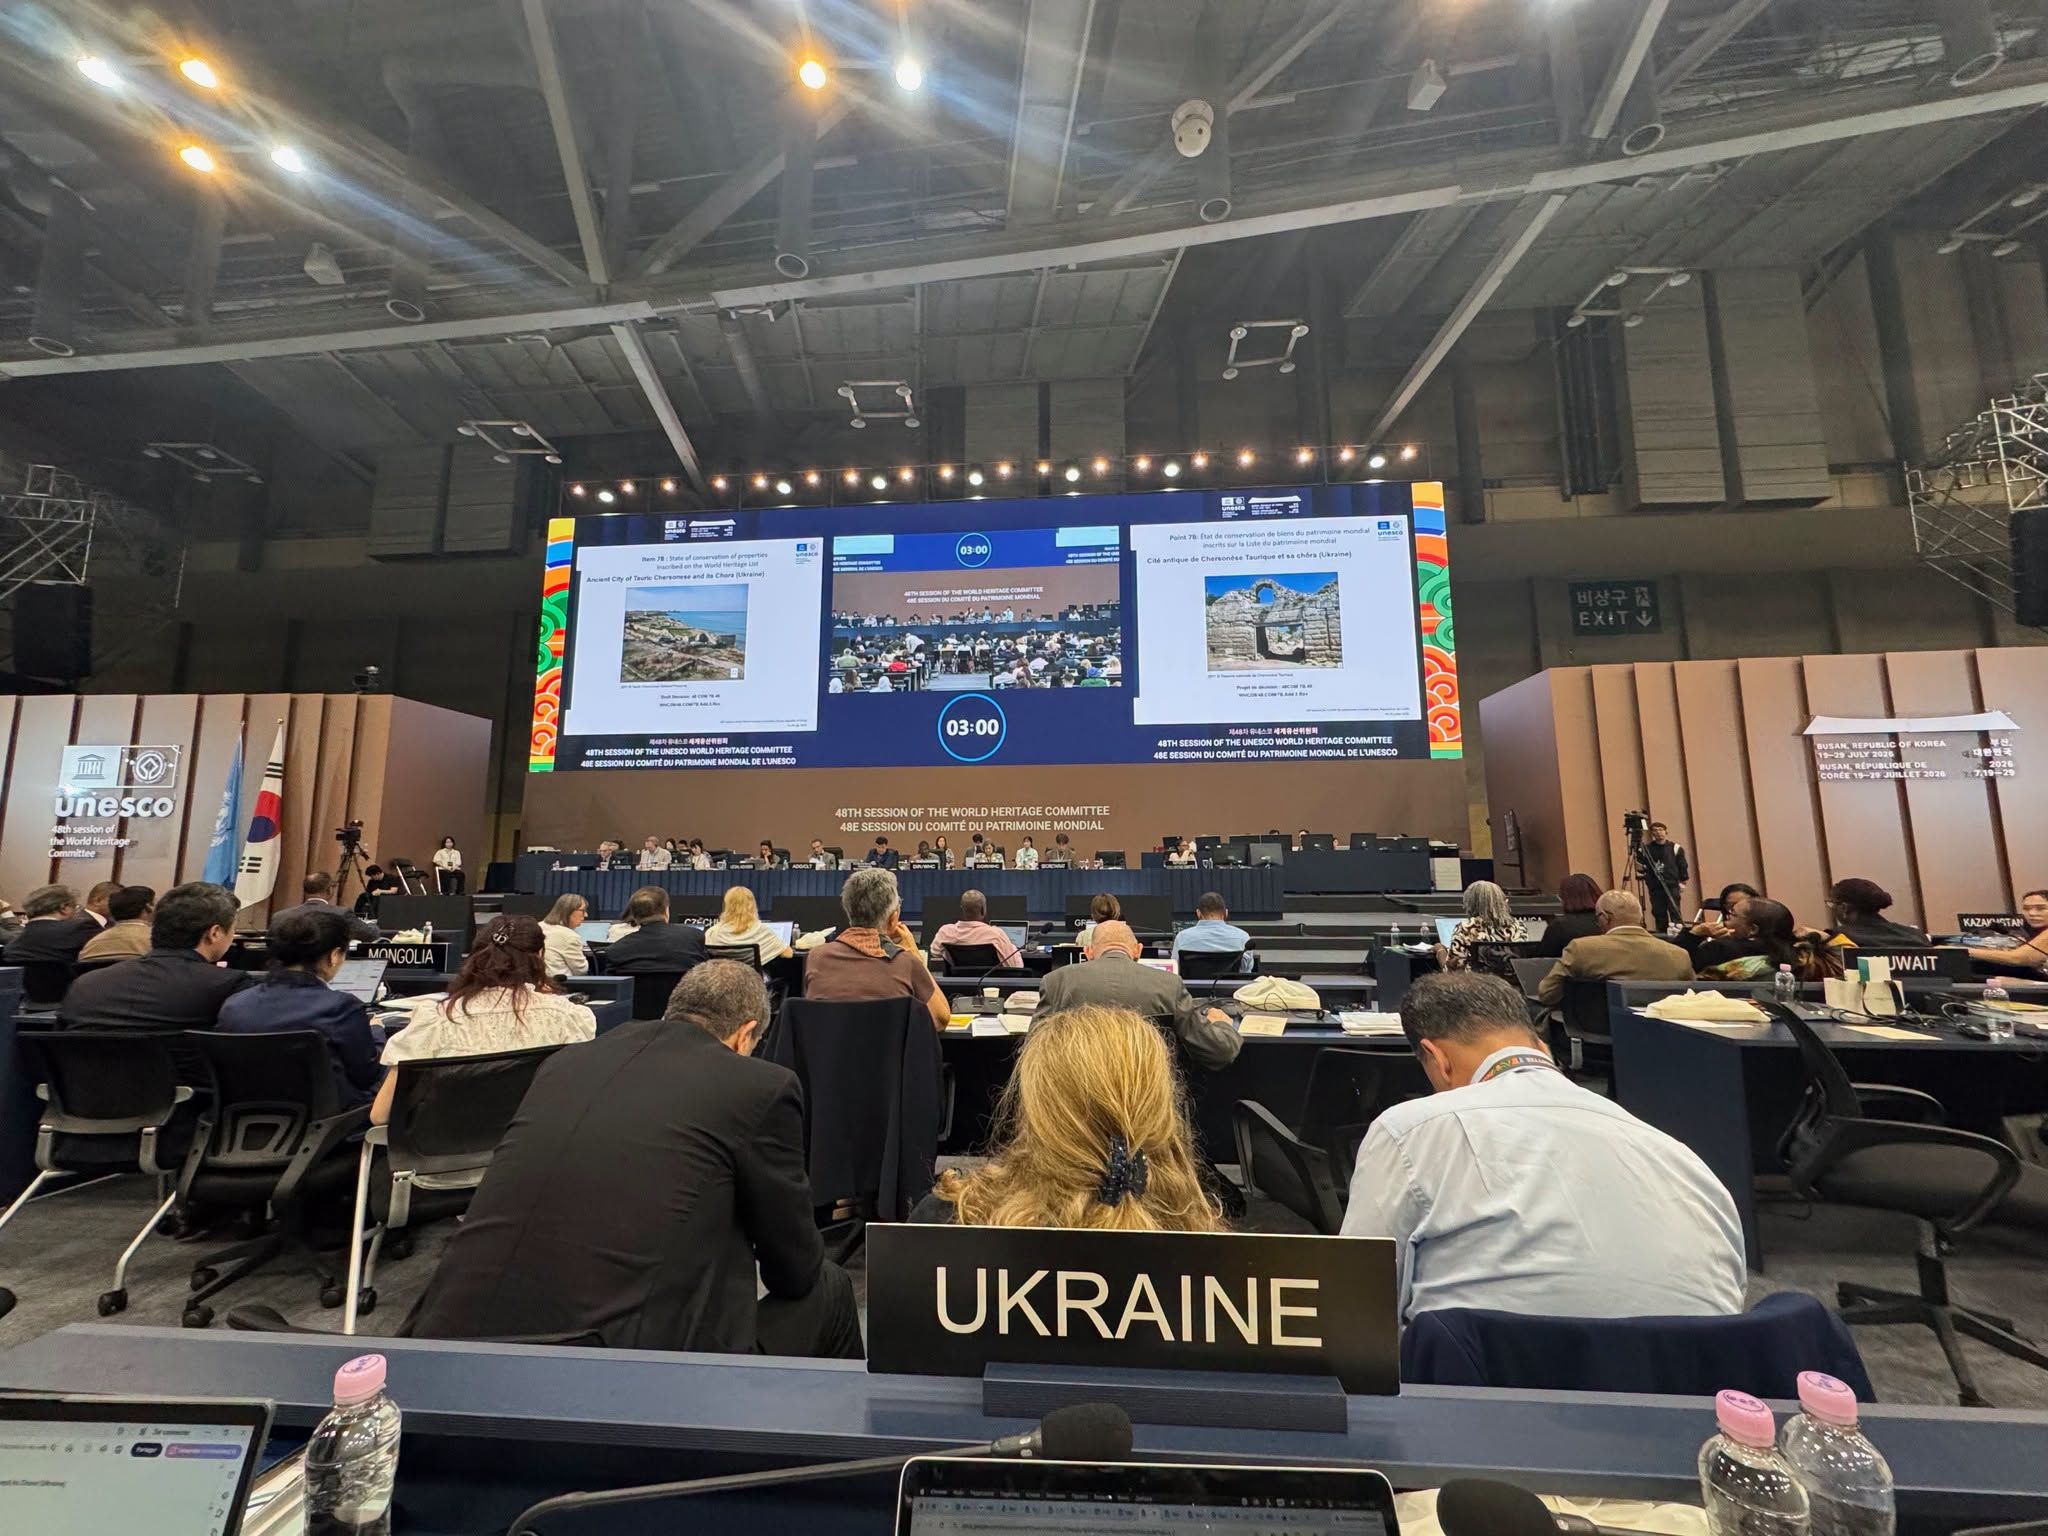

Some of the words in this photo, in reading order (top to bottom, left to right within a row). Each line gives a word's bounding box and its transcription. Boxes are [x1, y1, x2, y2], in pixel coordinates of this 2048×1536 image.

[960, 545, 988, 555] 03:00
[1319, 552, 1352, 560] (Ukraine)
[736, 571, 765, 579] (Ukraine)
[1576, 590, 1628, 606] 비상구
[1579, 610, 1629, 626] EXIT
[946, 719, 999, 736] 03:00
[1216, 750, 1246, 758] COMITÉ
[1260, 750, 1308, 758] PATRIMOINE
[1973, 748, 2012, 757] 대한민국
[636, 758, 662, 766] COMITÉ
[1854, 762, 1912, 770] RÉPUBLIQUE
[1820, 771, 1850, 779] CORÉE
[55, 796, 174, 818] unesco
[835, 808, 862, 817] 48TH
[864, 808, 908, 817] SESSION
[910, 808, 924, 816] OF
[928, 808, 948, 816] THE
[950, 807, 988, 816] WORLD
[991, 807, 1042, 816] HERITAGE
[1045, 806, 1110, 816] COMMITTEE
[52, 825, 72, 833] 48th
[73, 825, 104, 833] session
[105, 824, 116, 833] of
[840, 822, 859, 832] 48E
[861, 822, 906, 832] SESSION
[908, 822, 922, 831] DU
[926, 820, 966, 831] COMITÉ
[968, 822, 983, 830] DU
[986, 821, 1052, 830] PATRIMOINE
[1054, 820, 1104, 830] MONDIAL
[50, 837, 64, 846] the
[66, 837, 92, 846] World
[93, 837, 130, 848] Heritage
[48, 848, 96, 858] Committee
[368, 948, 434, 964] MONGOLIA
[1888, 956, 1938, 970] UWAIT
[936, 1266, 1322, 1347] UKRAINE
